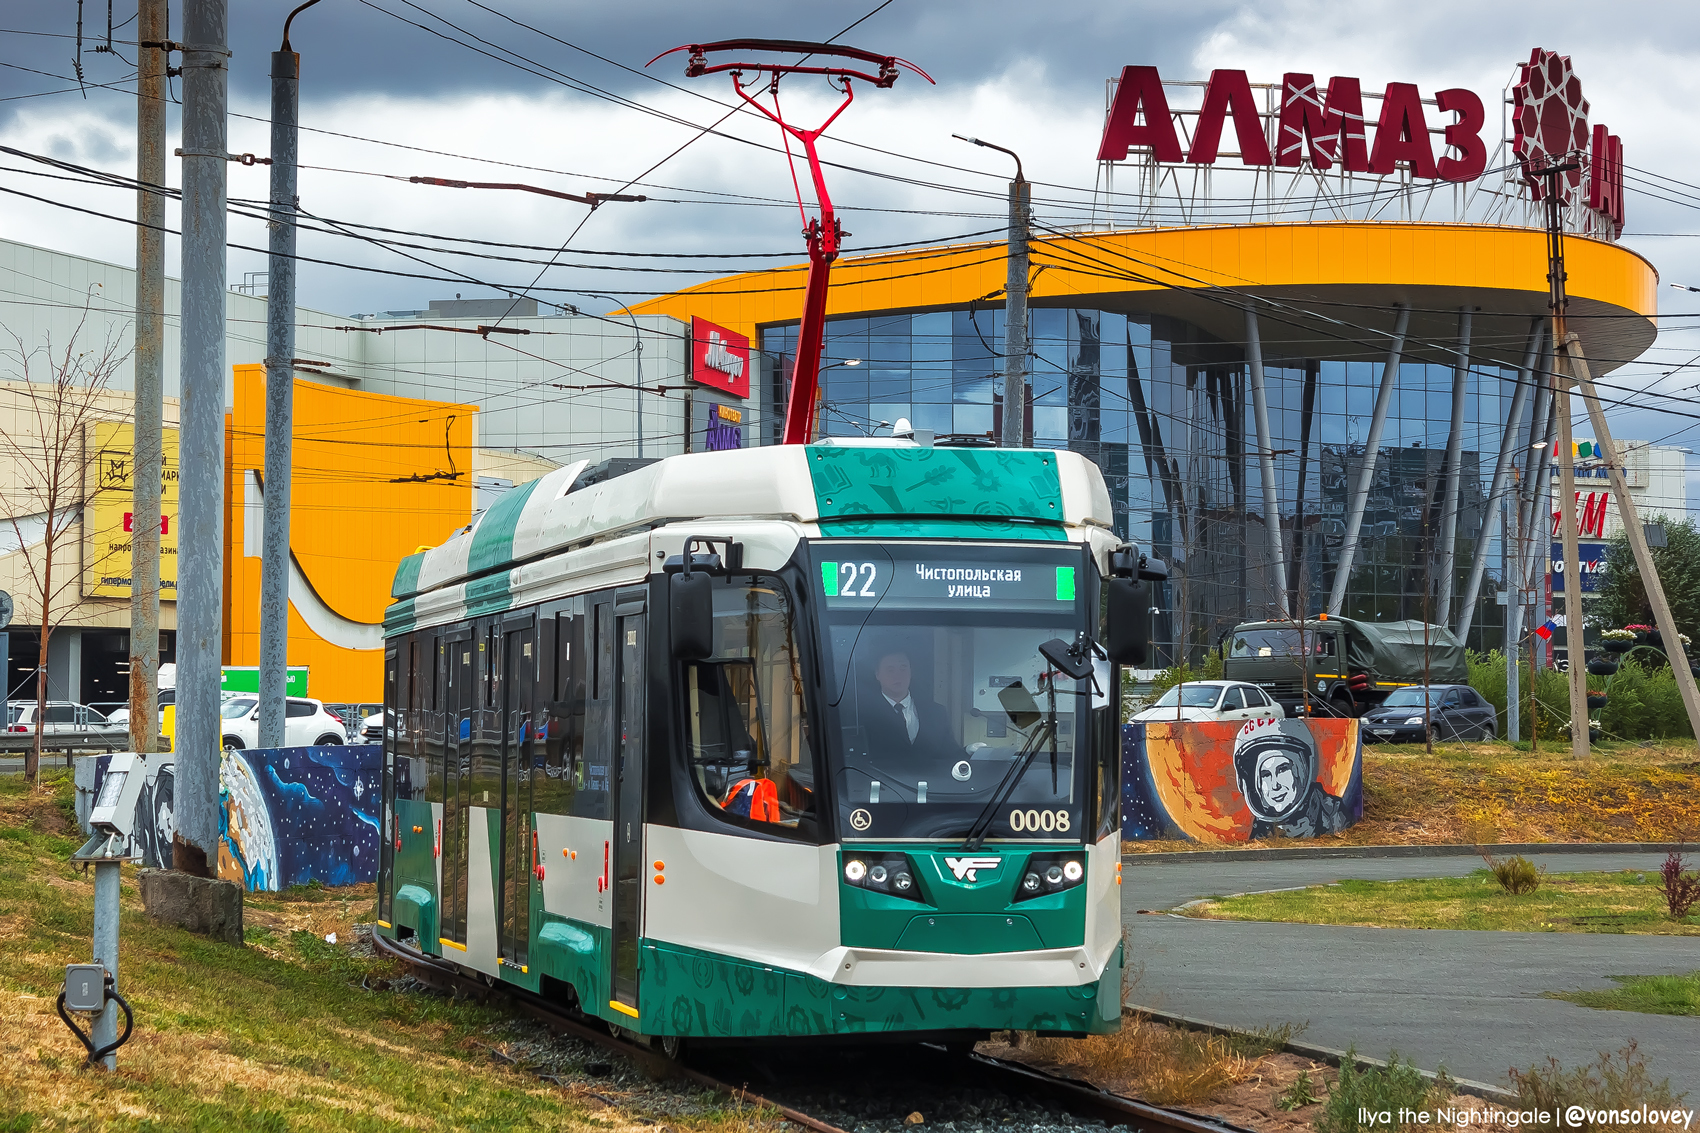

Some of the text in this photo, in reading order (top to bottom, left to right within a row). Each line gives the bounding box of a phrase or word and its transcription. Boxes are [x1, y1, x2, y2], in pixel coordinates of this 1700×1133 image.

[1097, 65, 1487, 183] АЛМАЗ
[109, 543, 132, 553] напро
[840, 562, 877, 597] 22
[915, 564, 1022, 582] Чистопольская
[948, 584, 991, 598] улица
[1009, 809, 1071, 832] 0008
